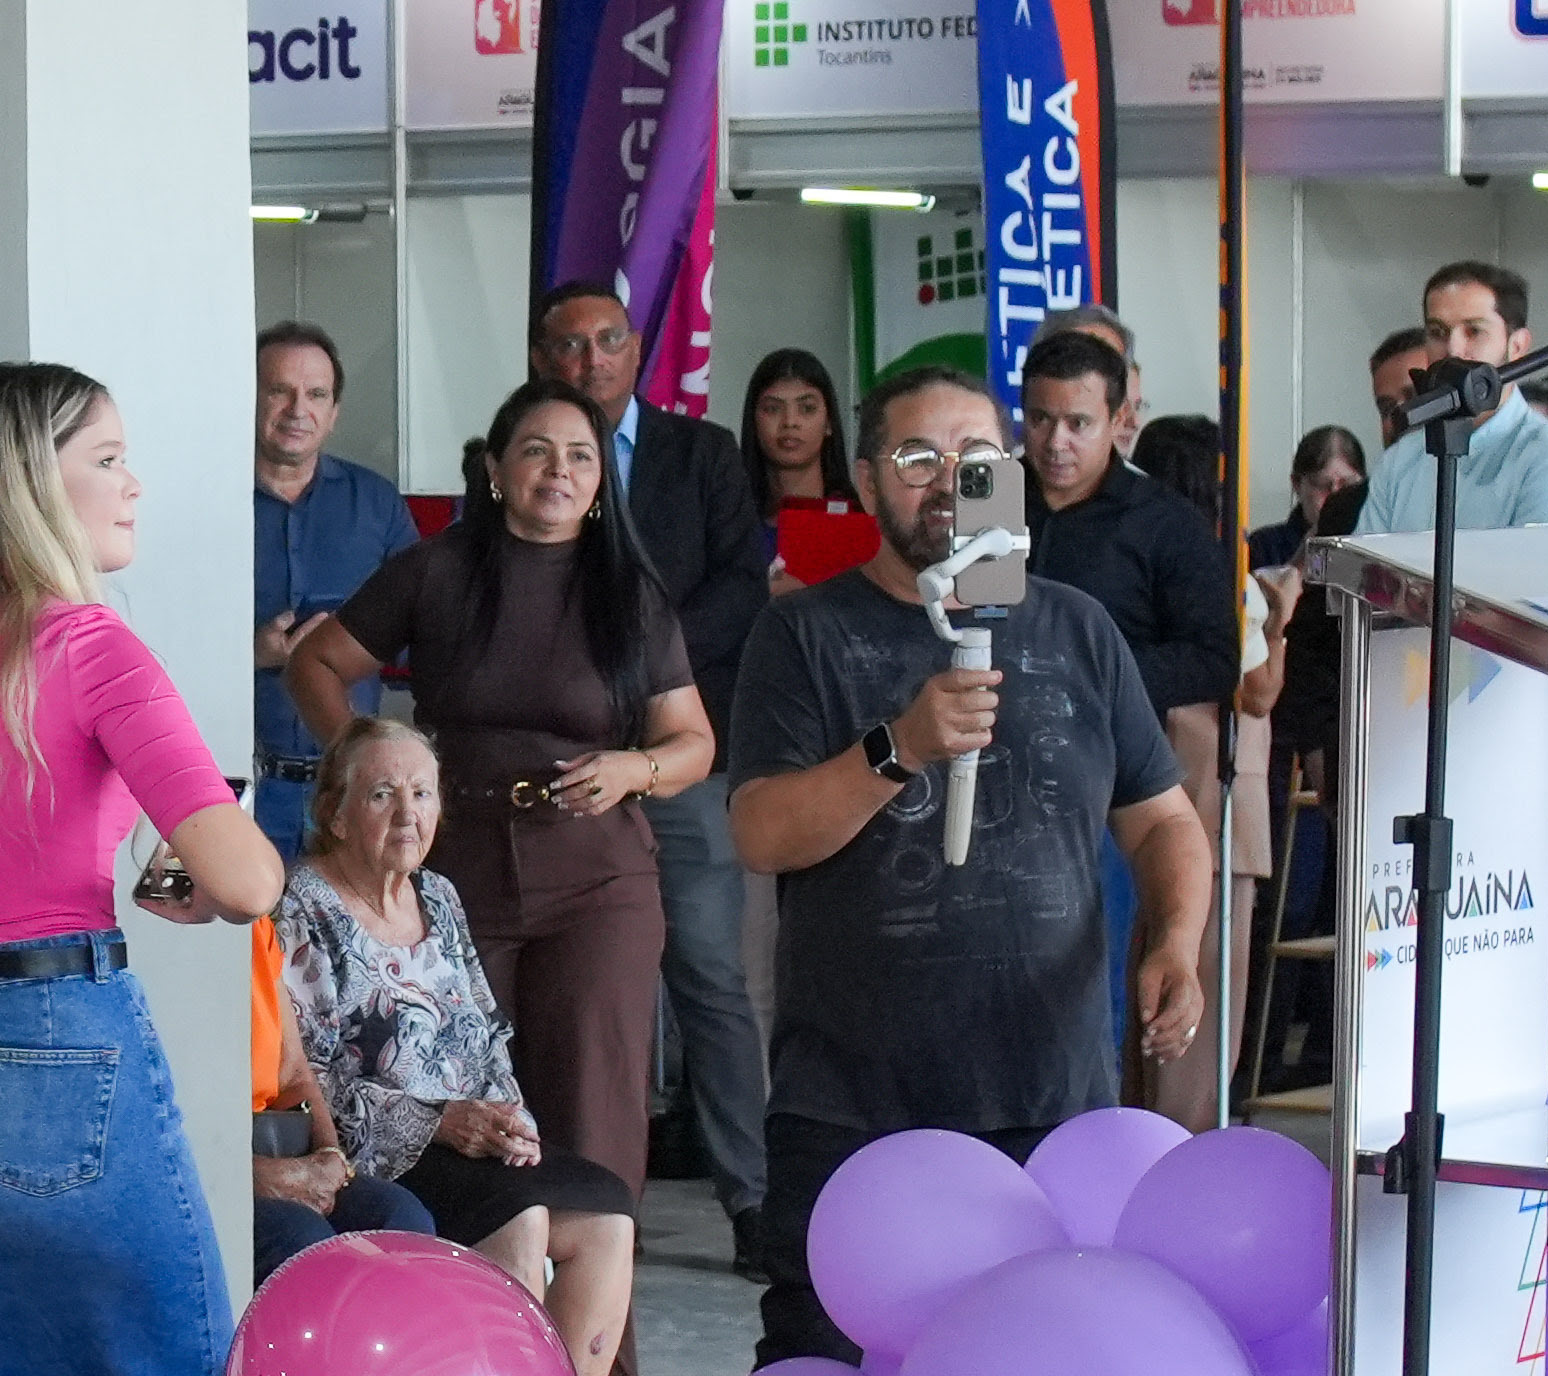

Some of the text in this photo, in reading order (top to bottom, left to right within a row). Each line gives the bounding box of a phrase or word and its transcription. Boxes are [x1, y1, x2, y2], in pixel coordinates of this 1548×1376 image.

[248, 15, 362, 84] acit
[817, 15, 978, 43] INSTITUTO FED
[818, 48, 893, 67] Tocantins
[1041, 79, 1082, 312] ÉTICA
[1365, 868, 1535, 931] ARAUAÍNA
[1444, 935, 1470, 960] QUE
[1473, 928, 1500, 954] NÃO
[1504, 926, 1536, 949] PARA
